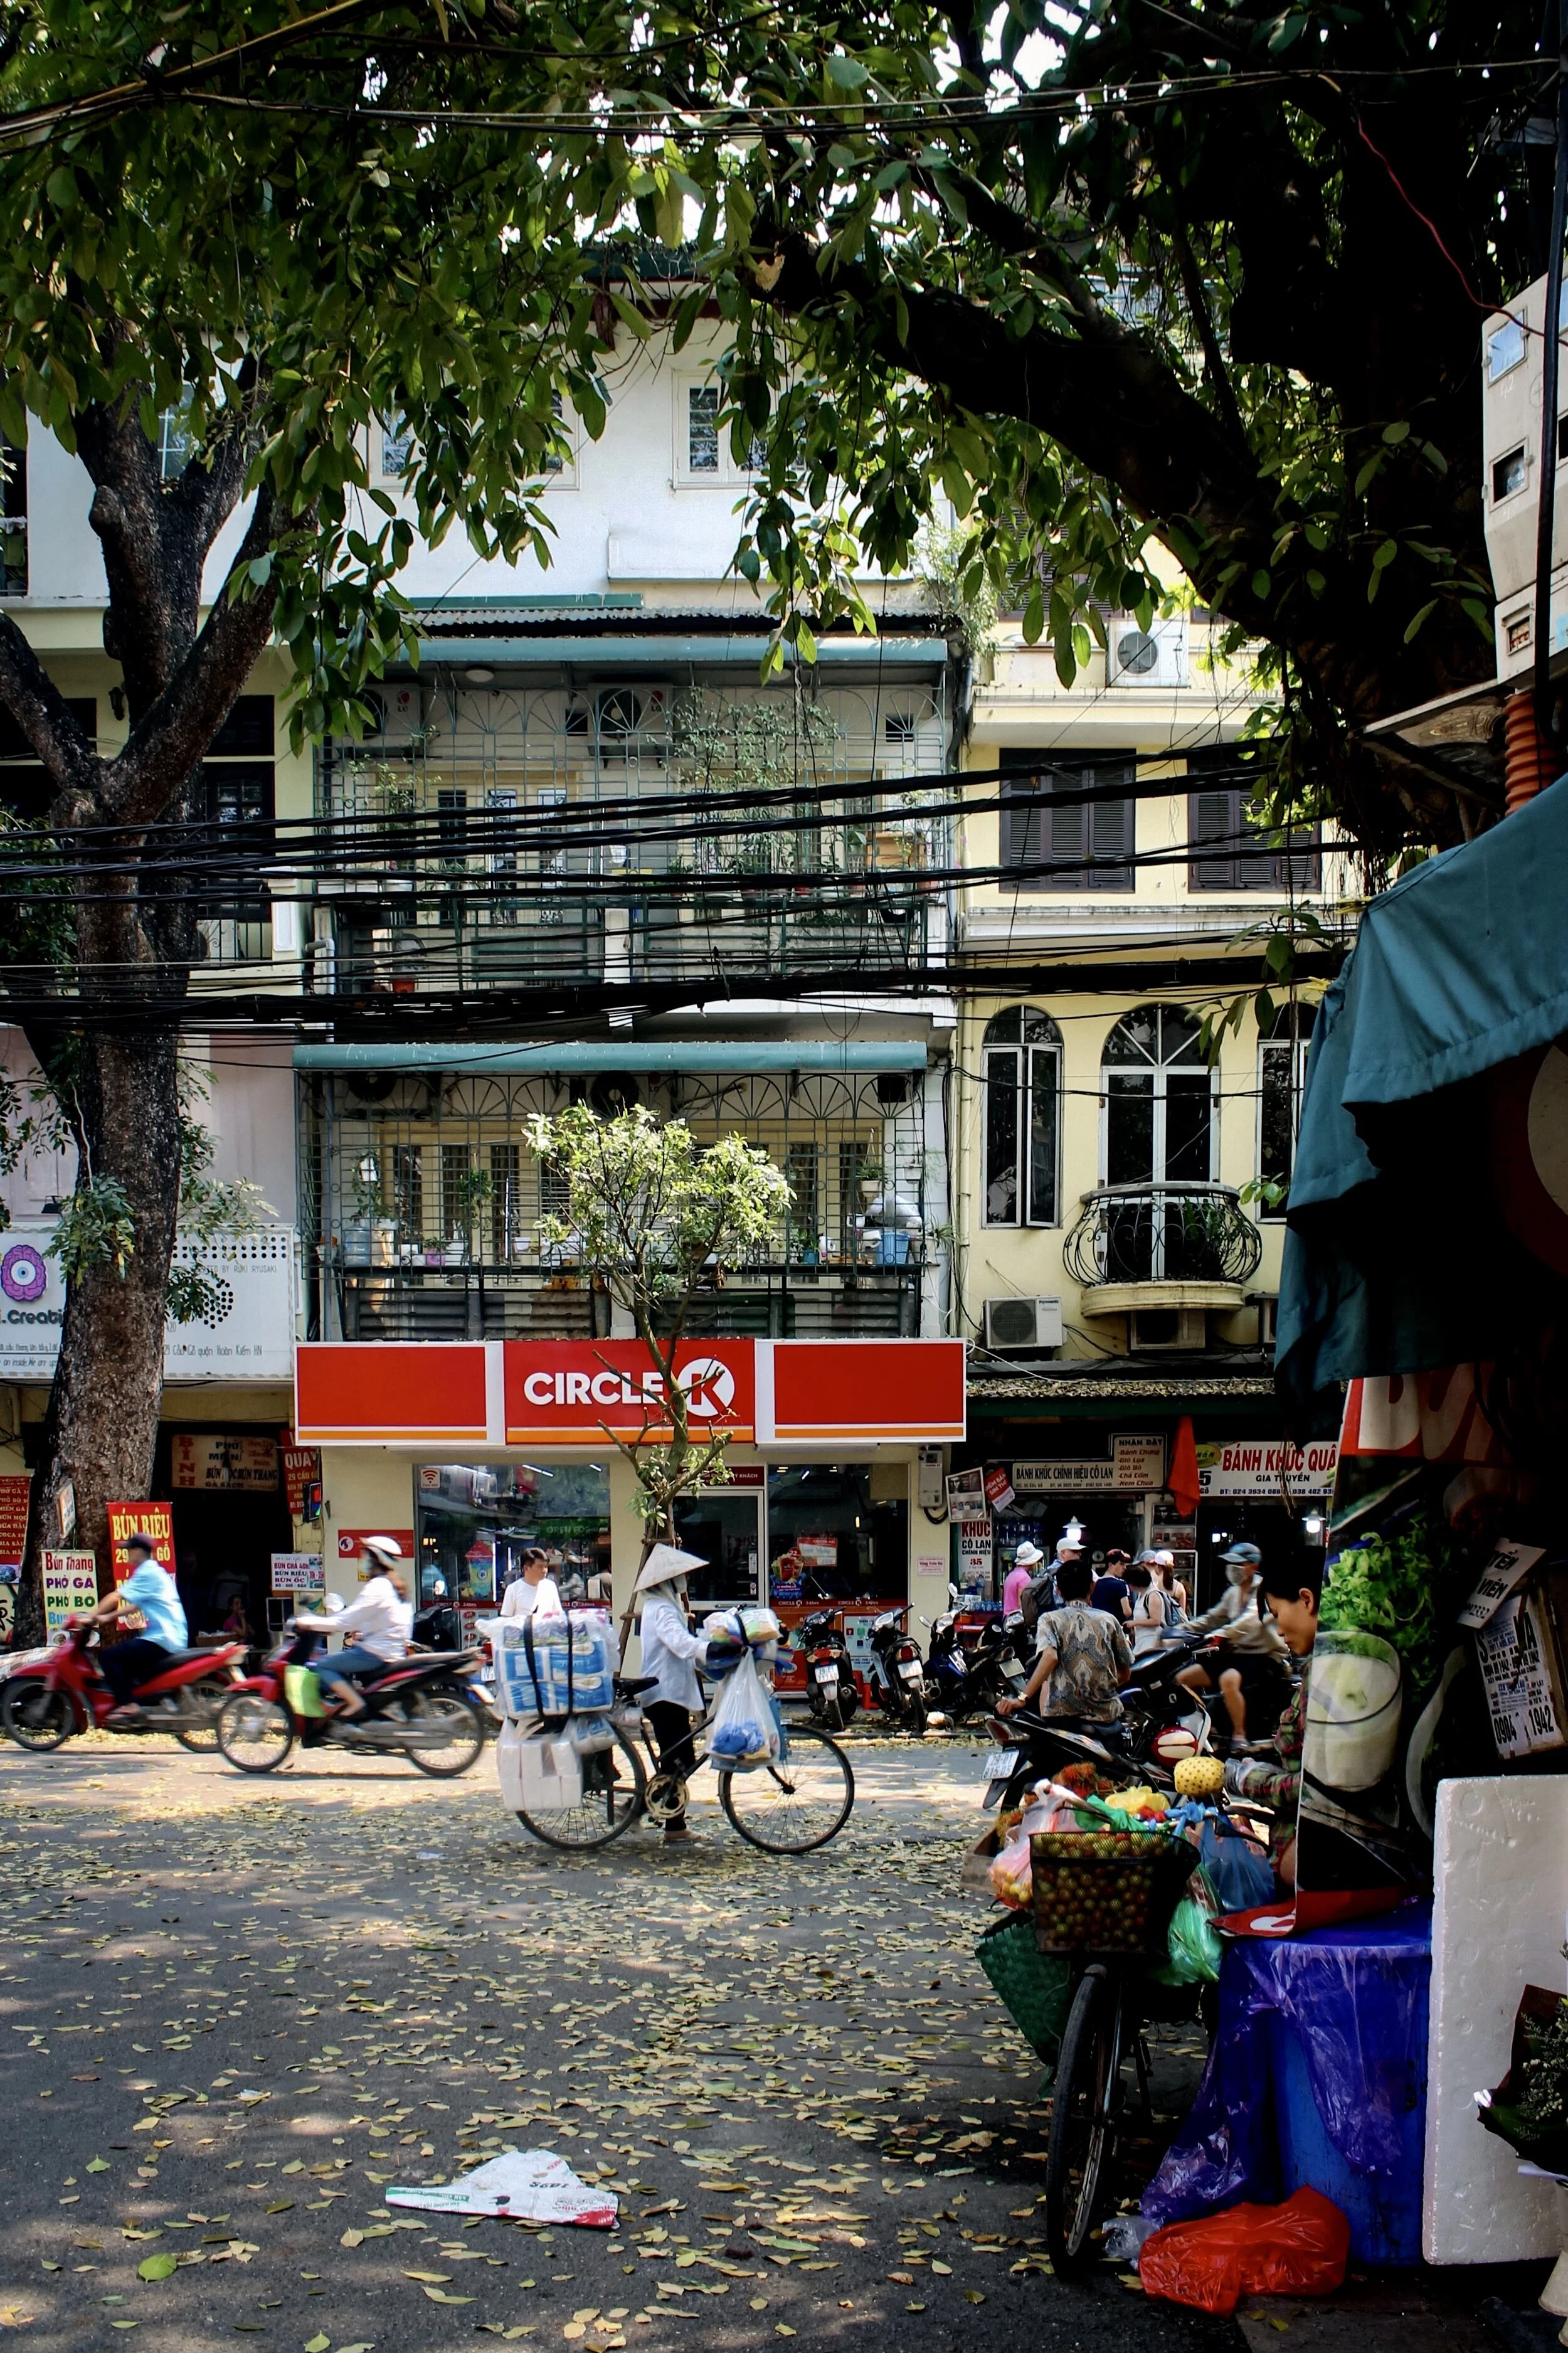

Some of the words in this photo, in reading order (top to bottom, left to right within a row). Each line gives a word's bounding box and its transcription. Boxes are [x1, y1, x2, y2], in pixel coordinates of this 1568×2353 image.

[524, 1372, 664, 1405] CIRCLE
[1222, 1443, 1263, 1471] BÁNH
[1265, 1443, 1305, 1471] KHÚC
[1308, 1443, 1336, 1472] QUÂ
[1016, 1465, 1033, 1479] BÁNH
[1035, 1465, 1051, 1479] KHÚC
[1053, 1465, 1072, 1479] CHÍNH
[1074, 1465, 1088, 1482] HIỆU
[1089, 1464, 1099, 1479] CÔ
[1101, 1467, 1113, 1479] LAN
[1199, 1470, 1212, 1485] 5
[112, 1507, 138, 1541] BÚN
[115, 1548, 129, 1563] 29
[156, 1541, 171, 1561] GỖ
[961, 1538, 973, 1549] CÔ
[975, 1539, 991, 1549] LAN
[45, 1553, 63, 1571] Bún
[66, 1556, 94, 1572] Thang
[73, 1575, 94, 1588] GÀ
[74, 1593, 95, 1607] BÒ
[1528, 1704, 1555, 1737] 1942
